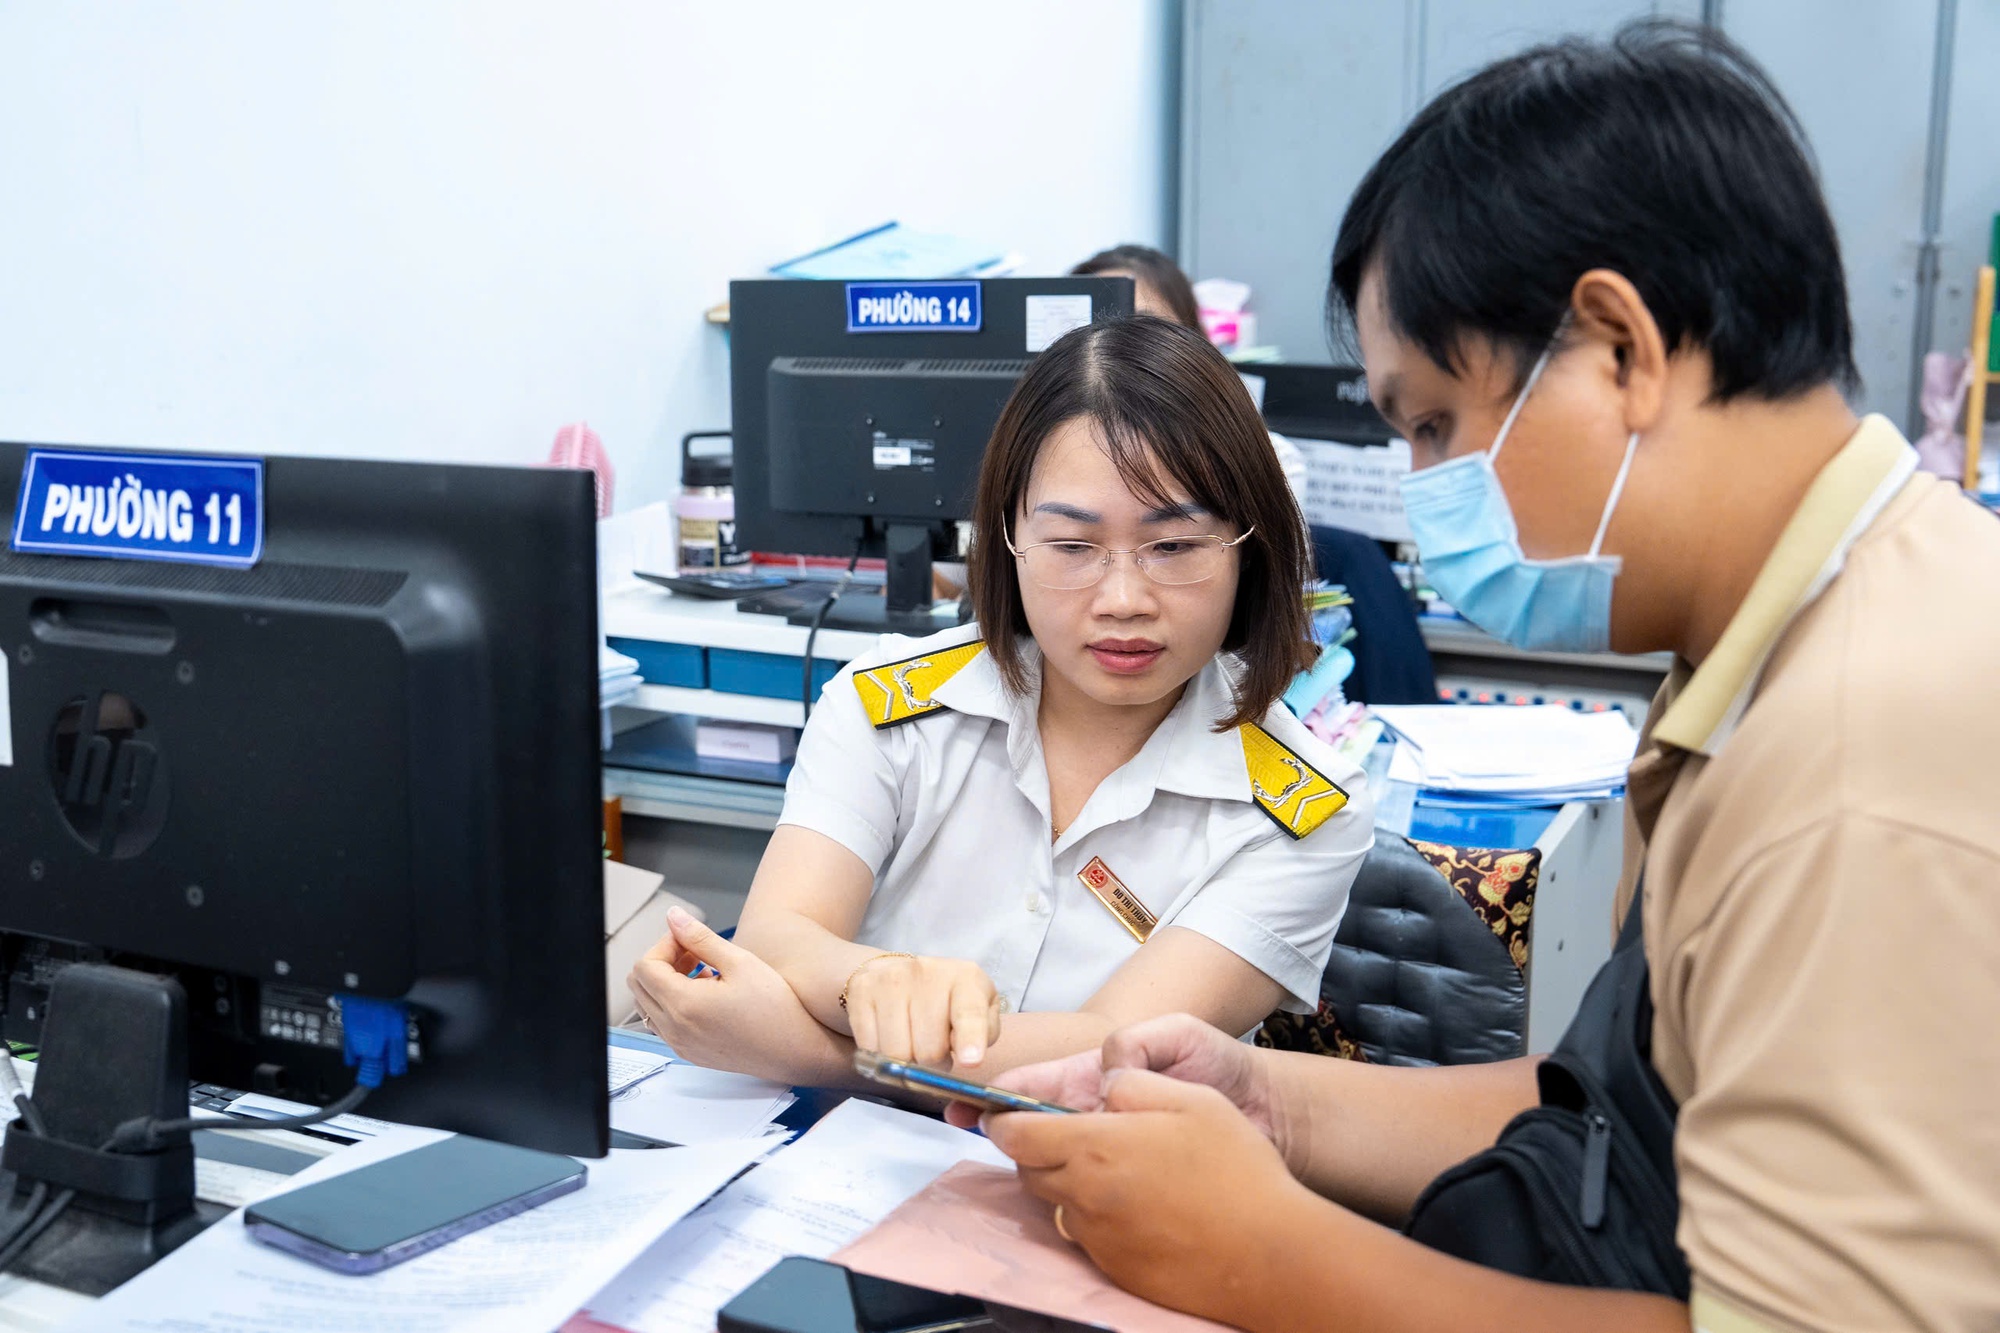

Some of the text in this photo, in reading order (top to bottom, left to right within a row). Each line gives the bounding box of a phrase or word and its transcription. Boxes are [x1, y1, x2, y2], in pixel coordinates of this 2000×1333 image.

[858, 290, 971, 324] PHƯỜNG 14
[40, 473, 242, 546] PHƯỜNG 11
